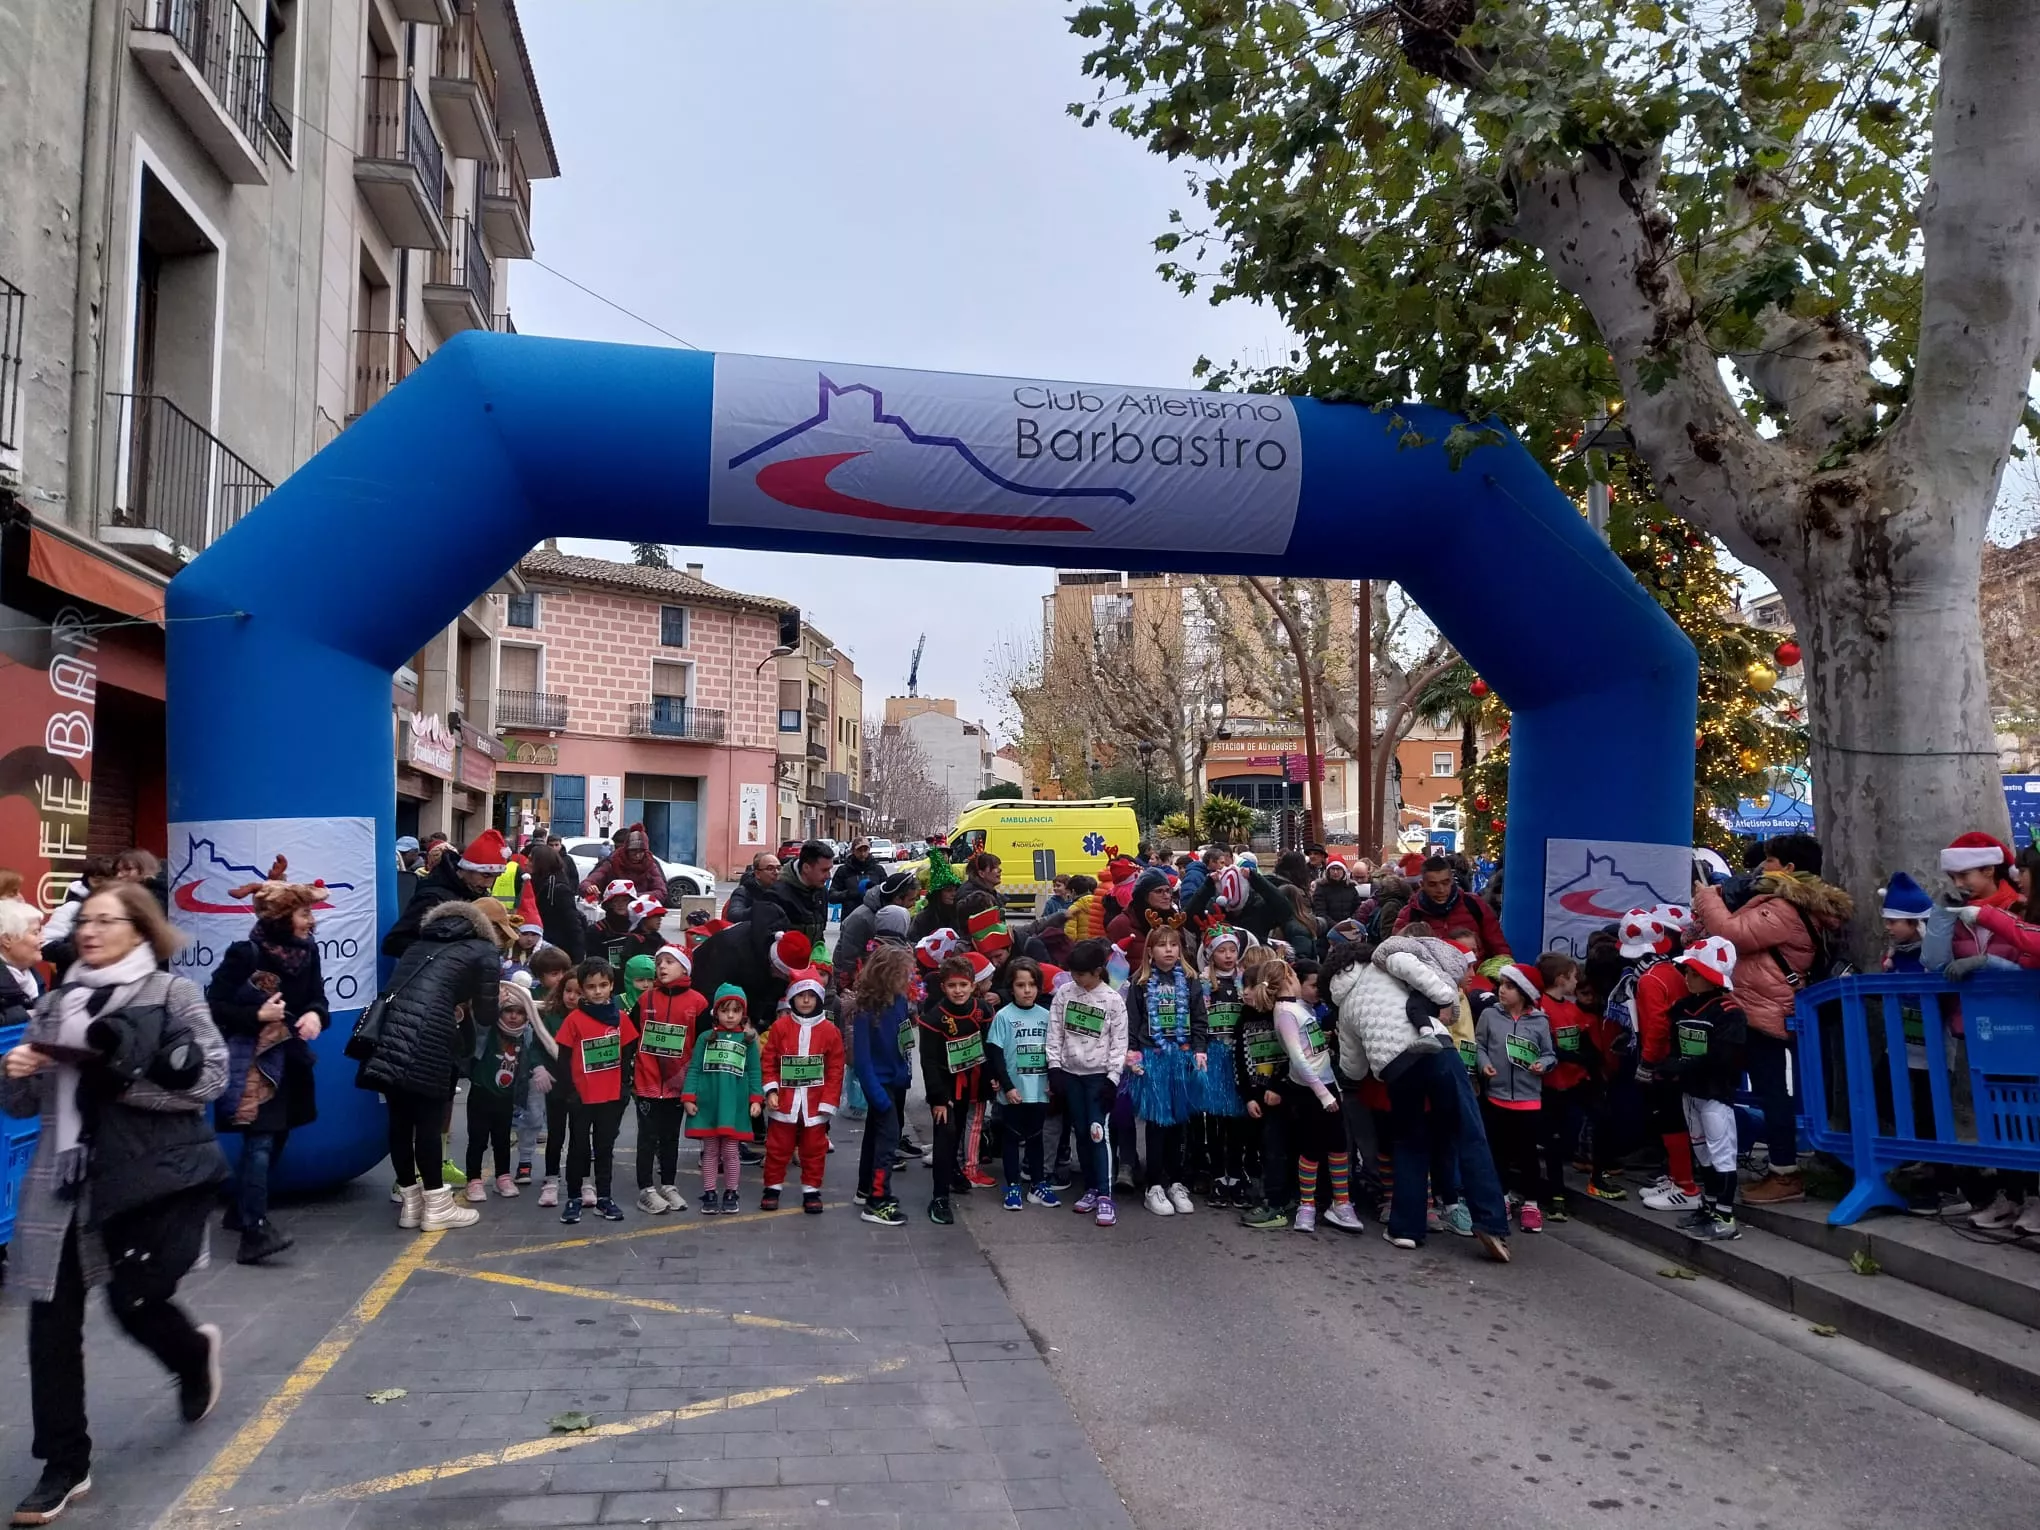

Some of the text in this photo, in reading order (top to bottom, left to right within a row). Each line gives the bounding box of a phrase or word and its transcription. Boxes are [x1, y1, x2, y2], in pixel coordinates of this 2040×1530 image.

[1013, 386, 1282, 422] Club Atletismo
[1015, 418, 1287, 471] Barbastro
[46, 605, 99, 759] BAR
[1248, 742, 1256, 751] DE
[1735, 820, 1771, 828] Atletismo
